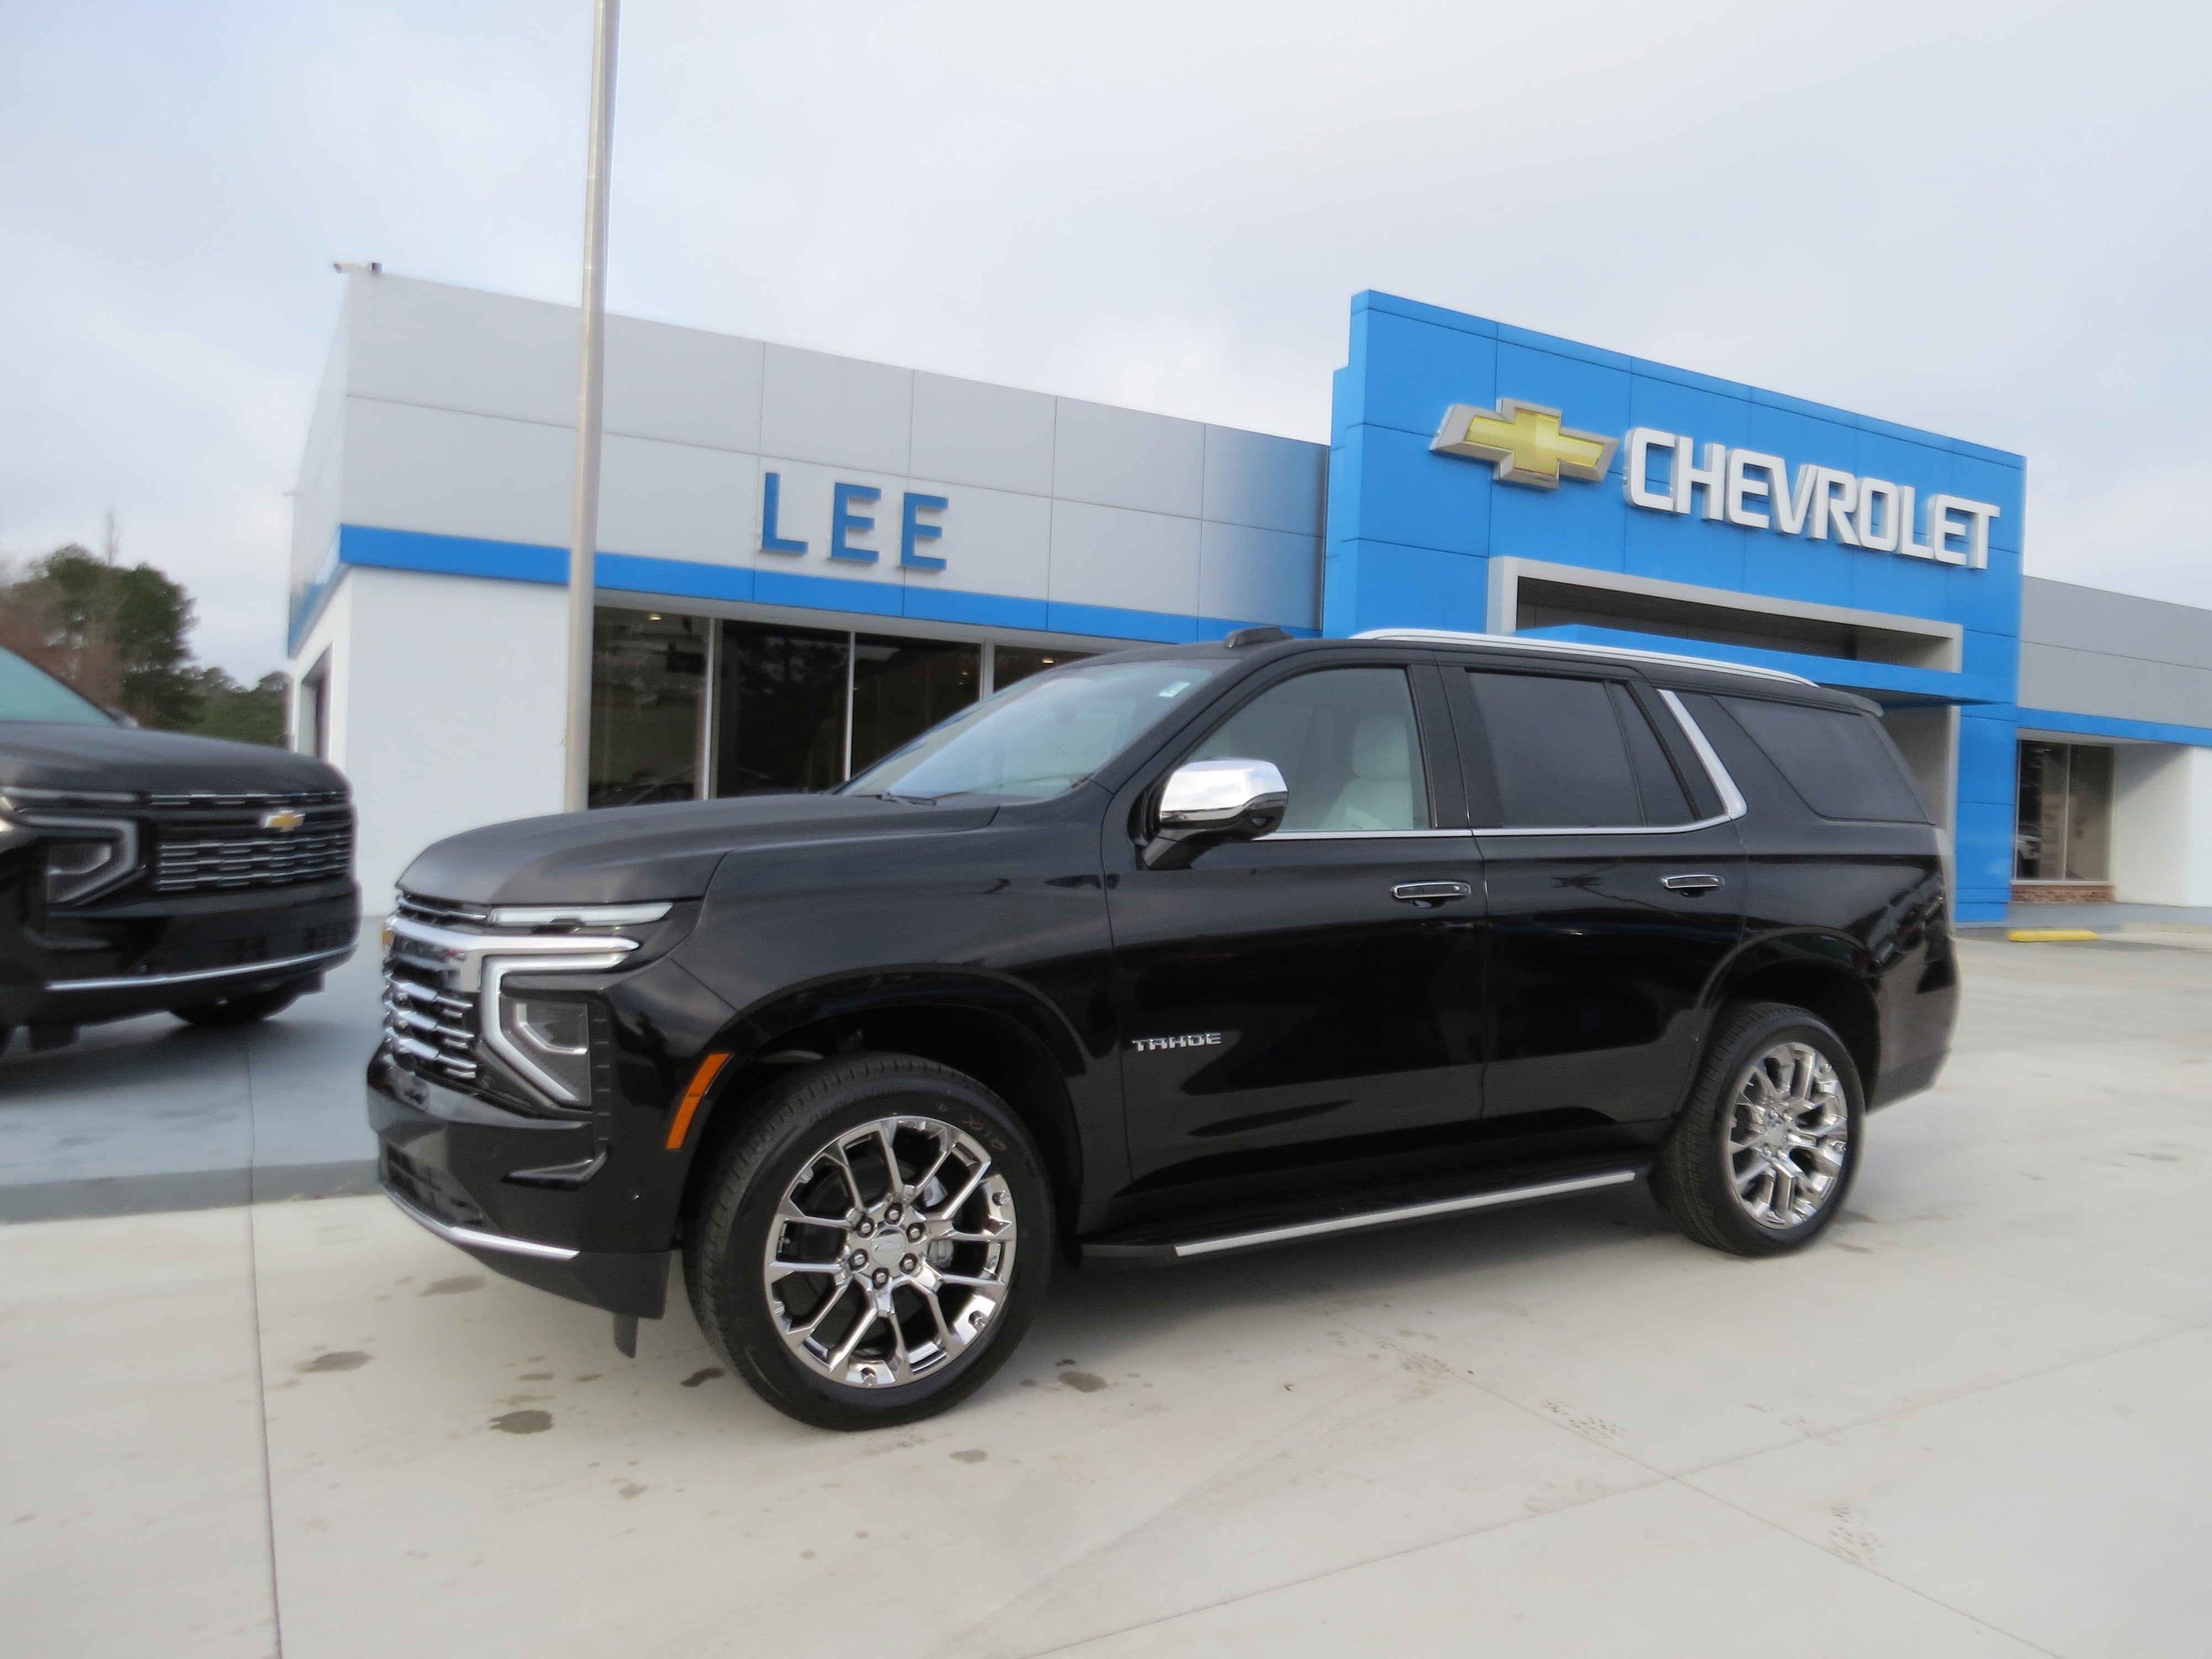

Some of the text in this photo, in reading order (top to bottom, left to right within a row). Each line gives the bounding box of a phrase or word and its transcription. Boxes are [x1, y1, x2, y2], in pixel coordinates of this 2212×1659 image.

[761, 472, 948, 571] LEE
[1623, 427, 2000, 570] CHEVROLET
[1133, 1032, 1222, 1051] TAHOE
